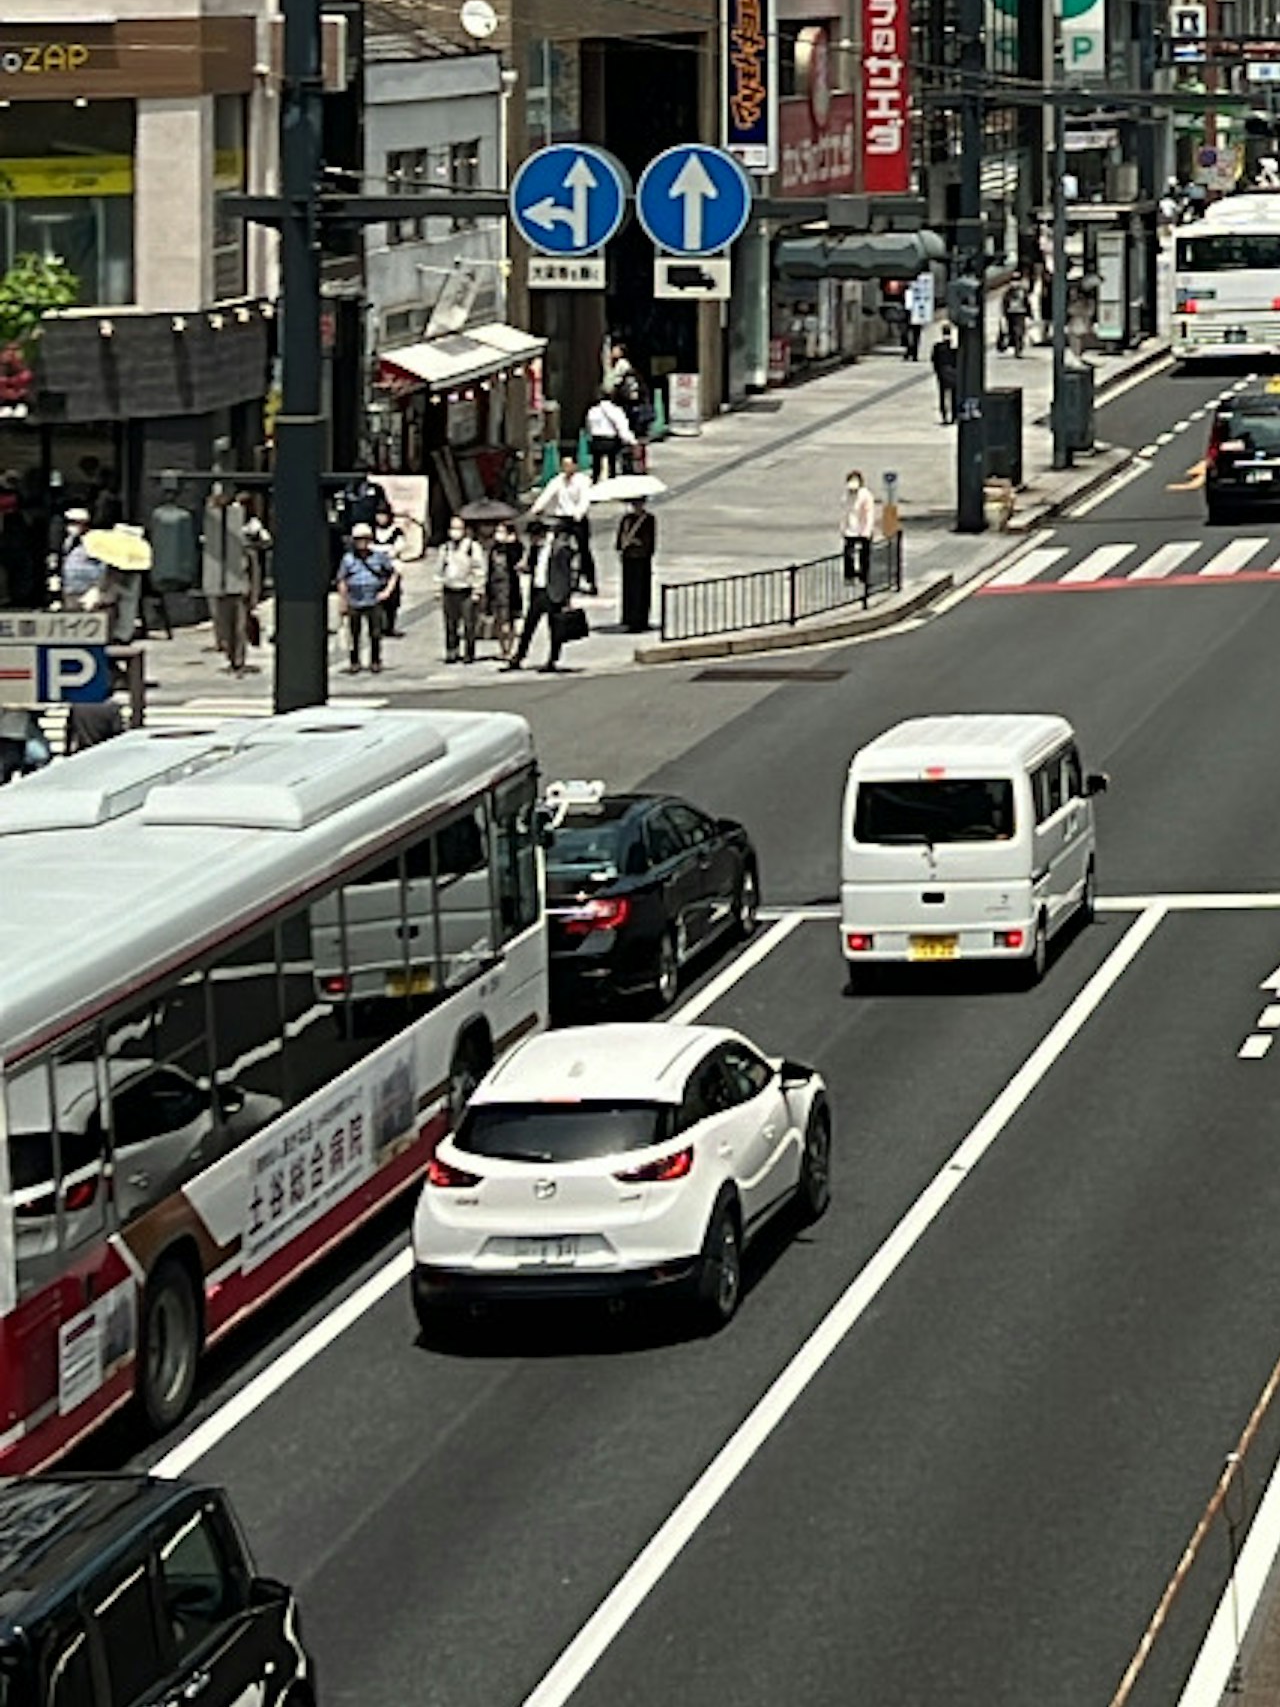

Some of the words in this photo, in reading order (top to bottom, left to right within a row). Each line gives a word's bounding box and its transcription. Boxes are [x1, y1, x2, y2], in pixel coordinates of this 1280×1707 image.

[1072, 39, 1093, 74] P
[47, 618, 102, 639] バイク
[47, 648, 98, 701] P
